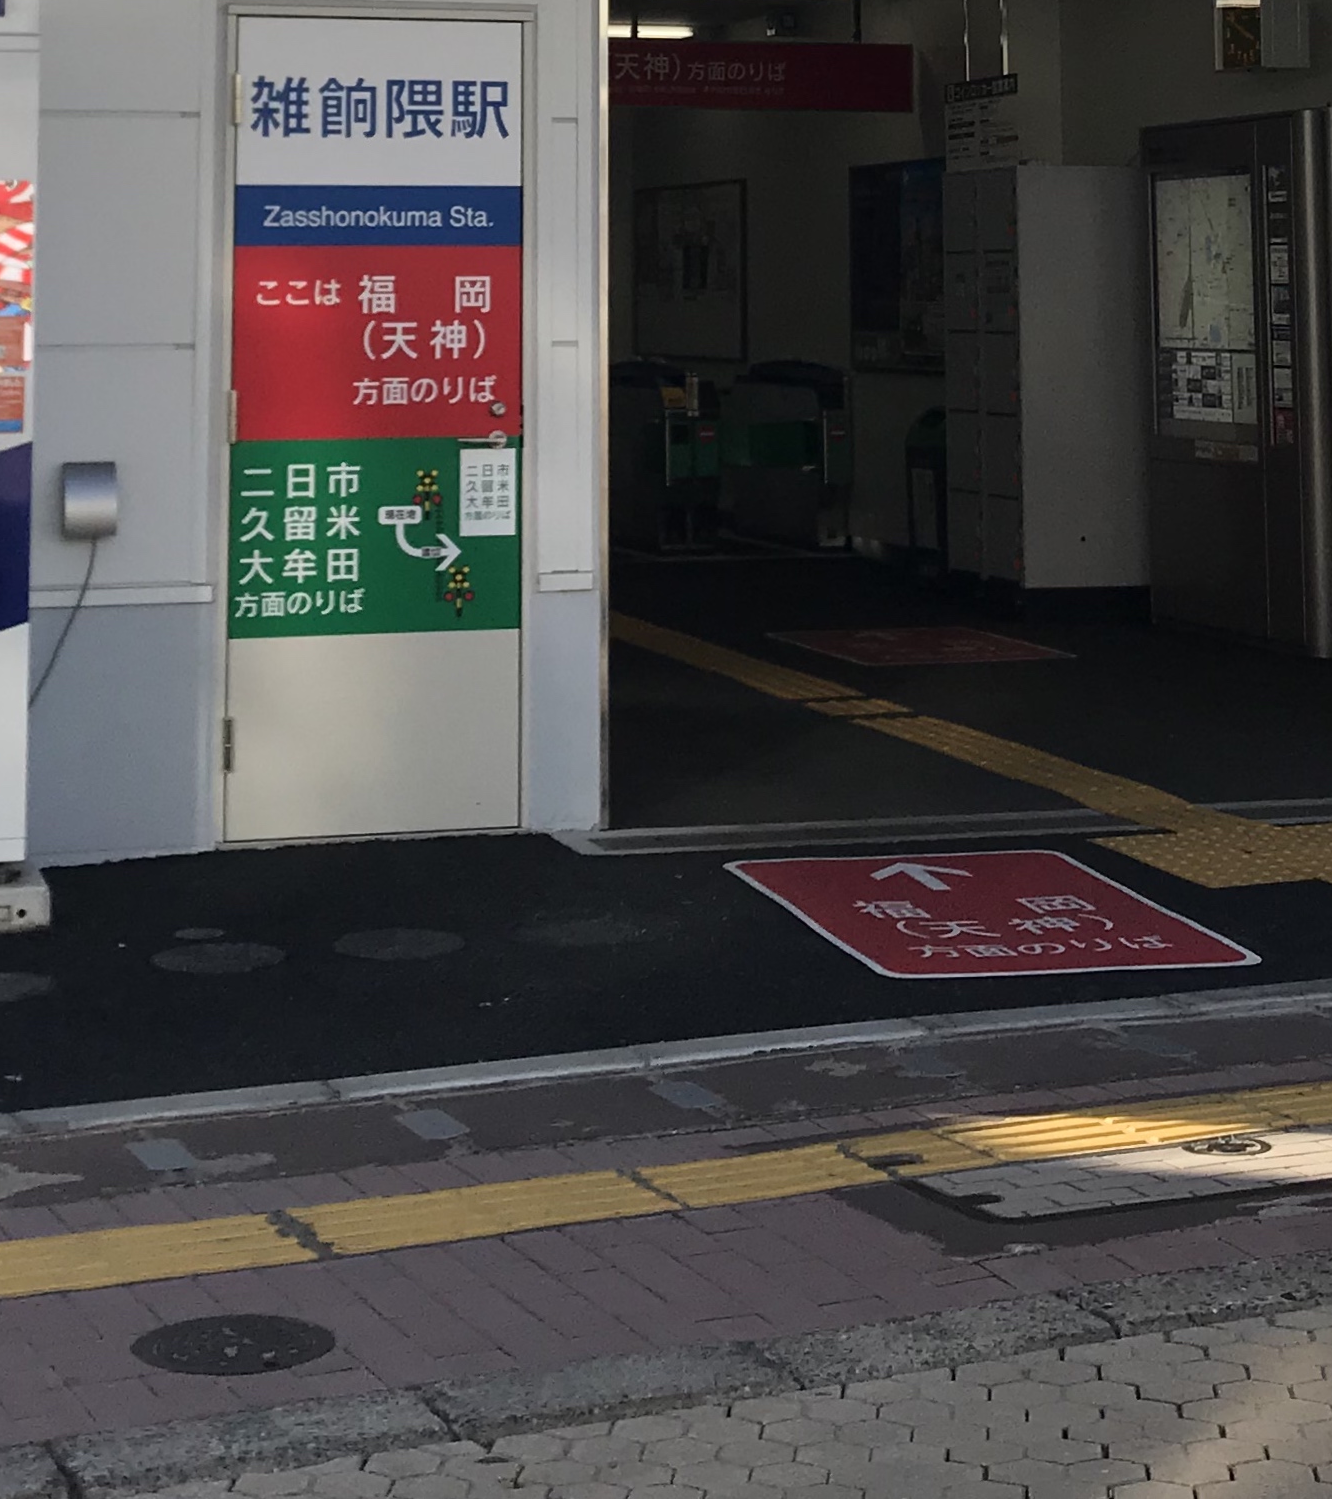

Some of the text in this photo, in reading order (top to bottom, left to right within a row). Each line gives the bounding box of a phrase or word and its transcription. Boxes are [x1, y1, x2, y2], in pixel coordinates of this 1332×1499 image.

[687, 60, 787, 83] 方面のりば
[250, 75, 509, 139] 雑餉隈駅
[263, 205, 495, 228] Zasshonokuma Sta.
[255, 279, 343, 306] ここは
[363, 319, 486, 360] (天神)
[352, 375, 497, 405] 方面のりば
[240, 462, 362, 499] 二日市
[240, 505, 362, 542] 久留米
[238, 548, 360, 585] 大牟田
[234, 588, 365, 618] 方面のりば
[908, 935, 1175, 959] 方面のりば
